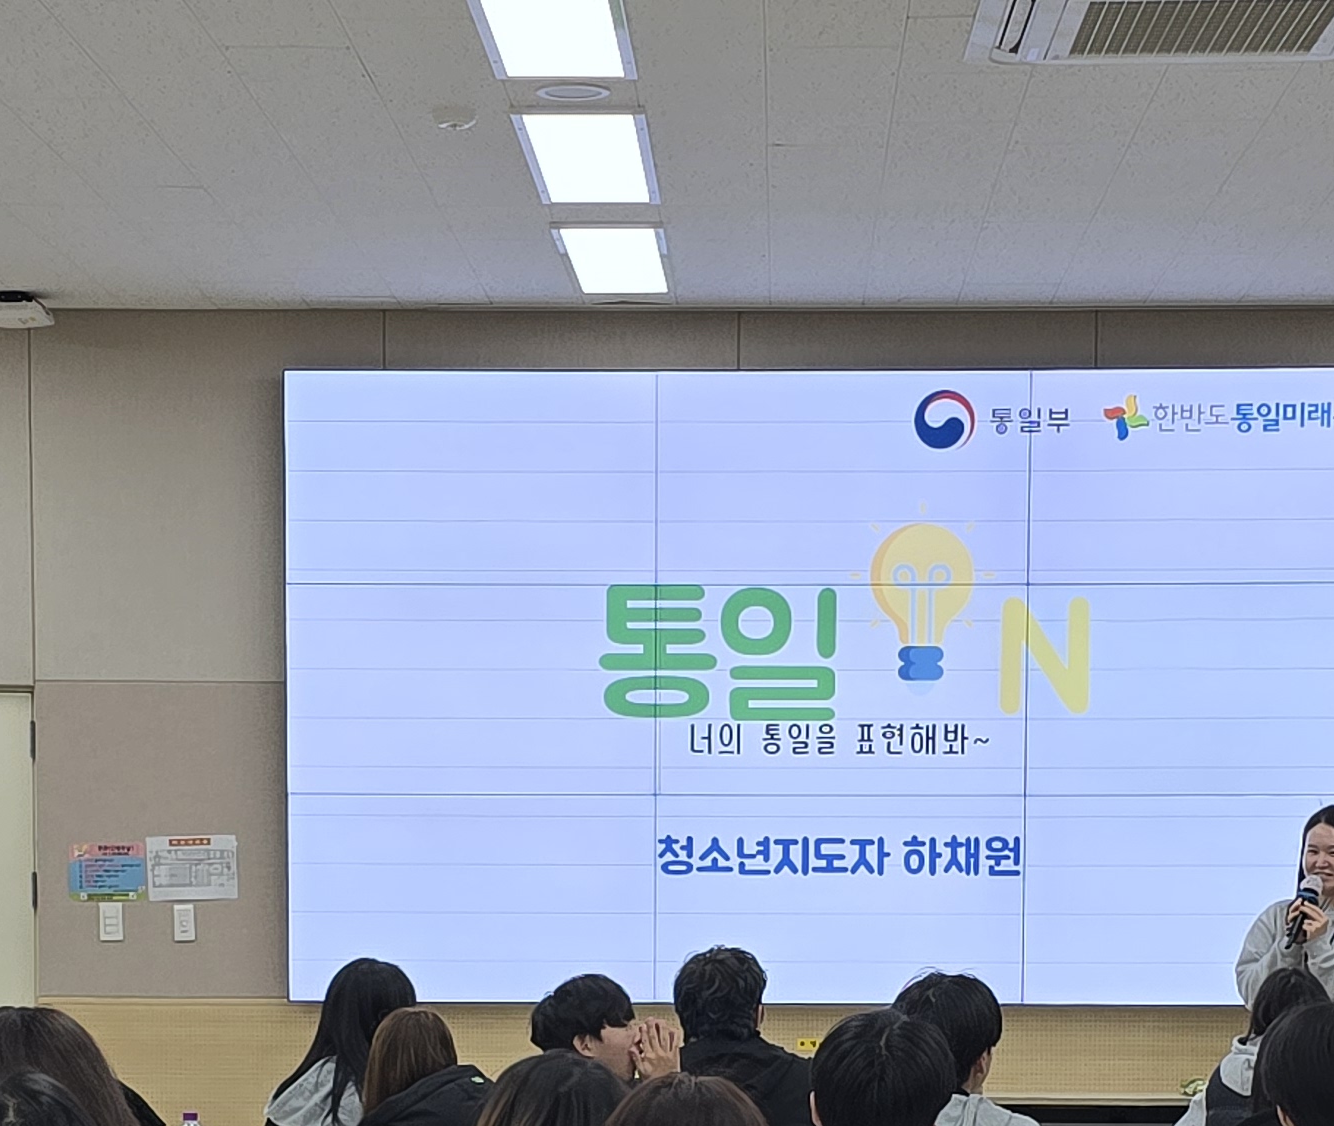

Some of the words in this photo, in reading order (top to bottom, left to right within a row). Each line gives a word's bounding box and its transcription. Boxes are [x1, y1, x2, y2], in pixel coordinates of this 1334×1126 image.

[989, 406, 1071, 434] 통일부
[598, 584, 837, 721] 통일
[688, 723, 743, 756] 너의
[761, 723, 837, 755] 통일을
[855, 723, 990, 756] 표현해봐~
[657, 835, 891, 876] 청소년지도자
[902, 835, 1022, 877] 하채원
